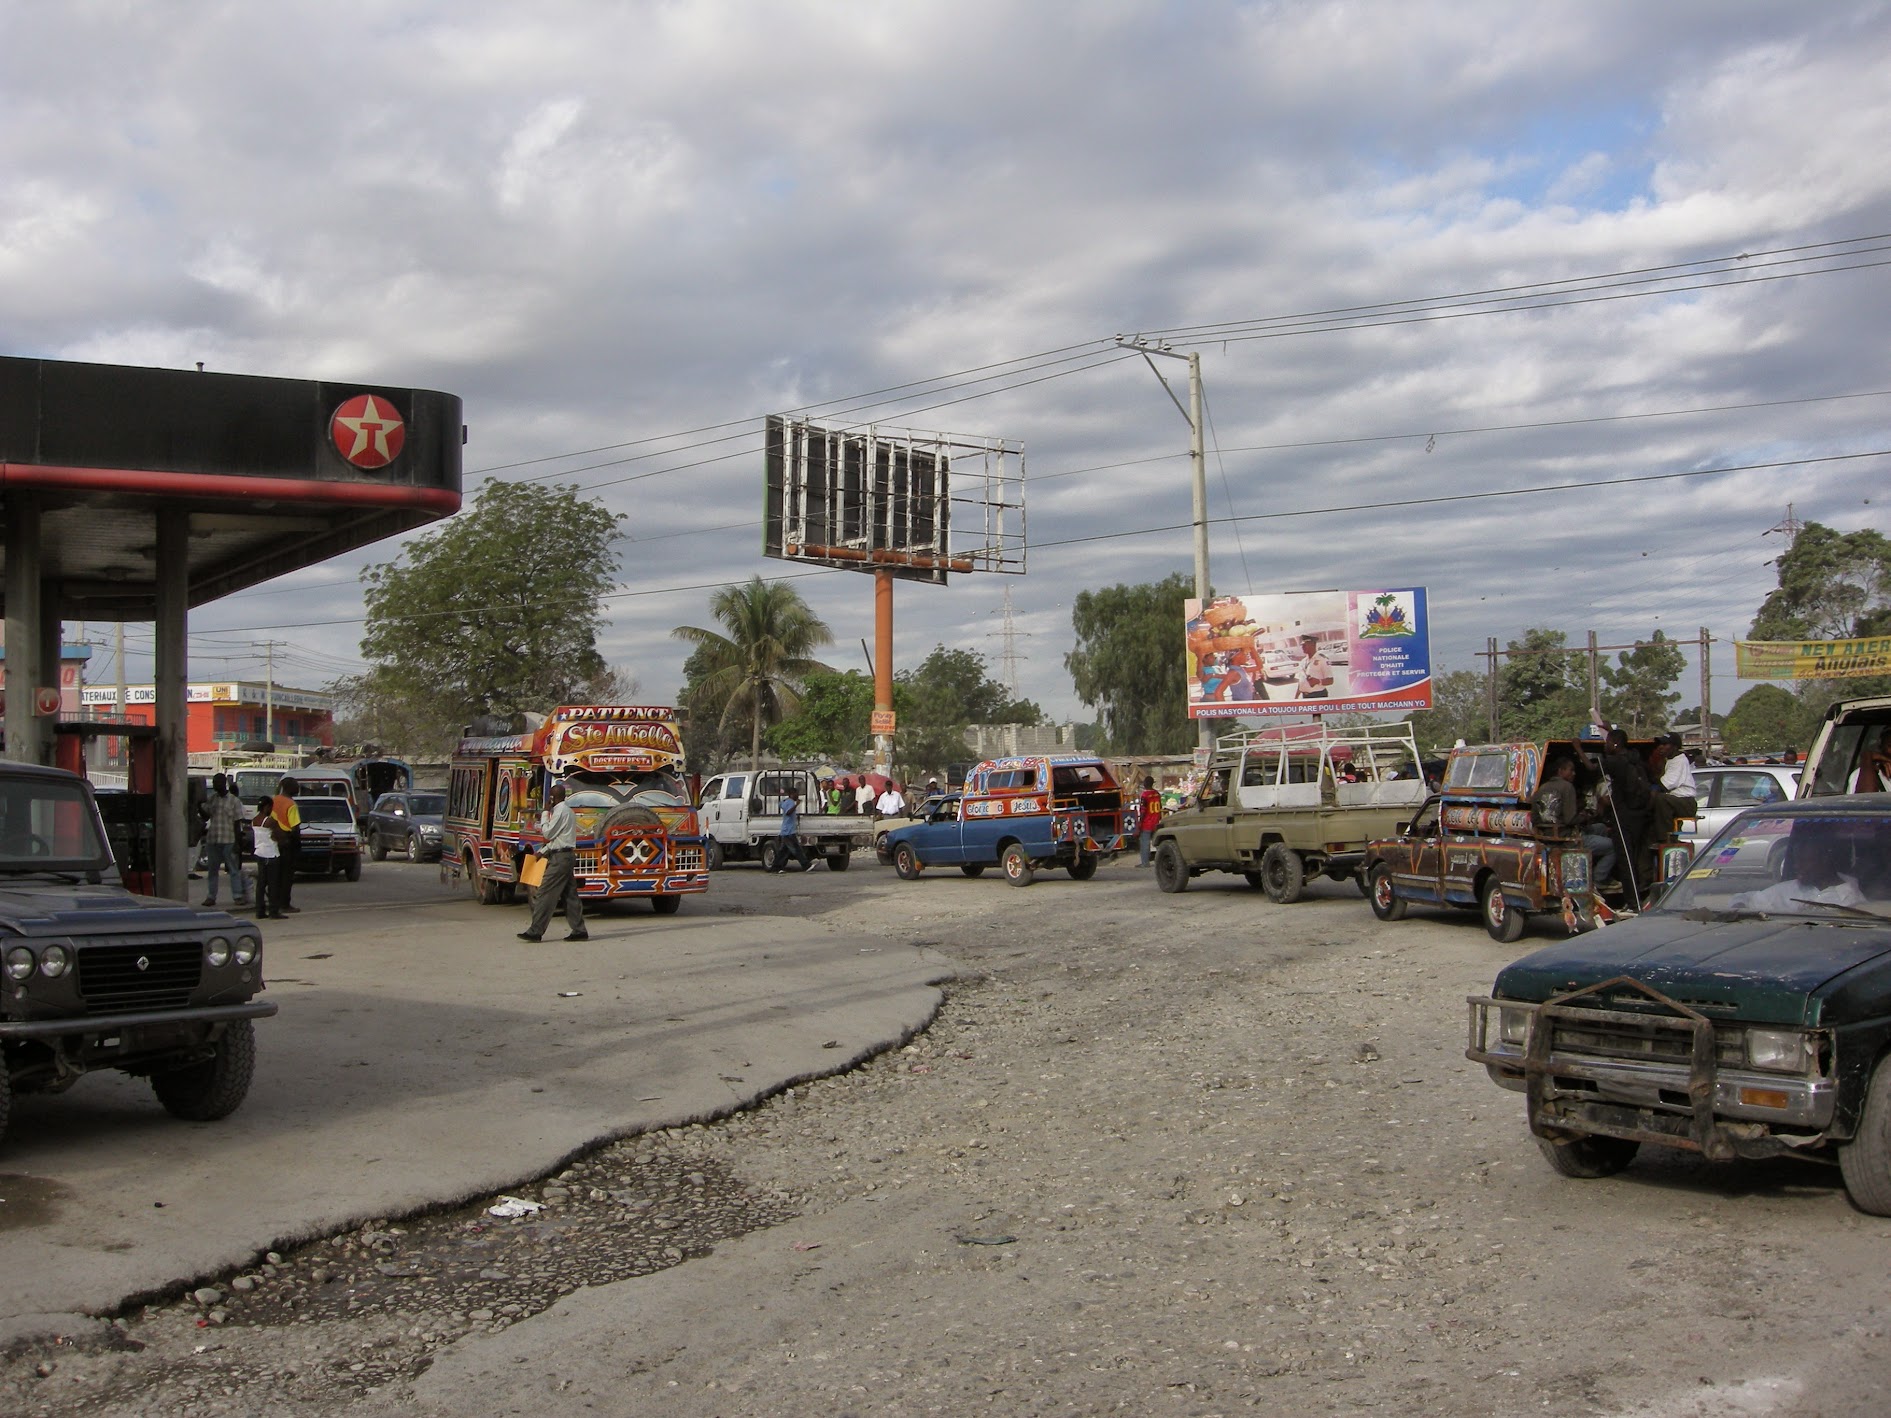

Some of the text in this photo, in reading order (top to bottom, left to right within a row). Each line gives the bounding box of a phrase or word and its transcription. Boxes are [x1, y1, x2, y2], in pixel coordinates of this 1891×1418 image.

[1801, 643, 1836, 656] NEW
[82, 691, 116, 701] ATERIAUX
[567, 707, 669, 720] PATIENCE
[1218, 707, 1256, 716] NASYONAL
[1377, 700, 1414, 708] MACHANN
